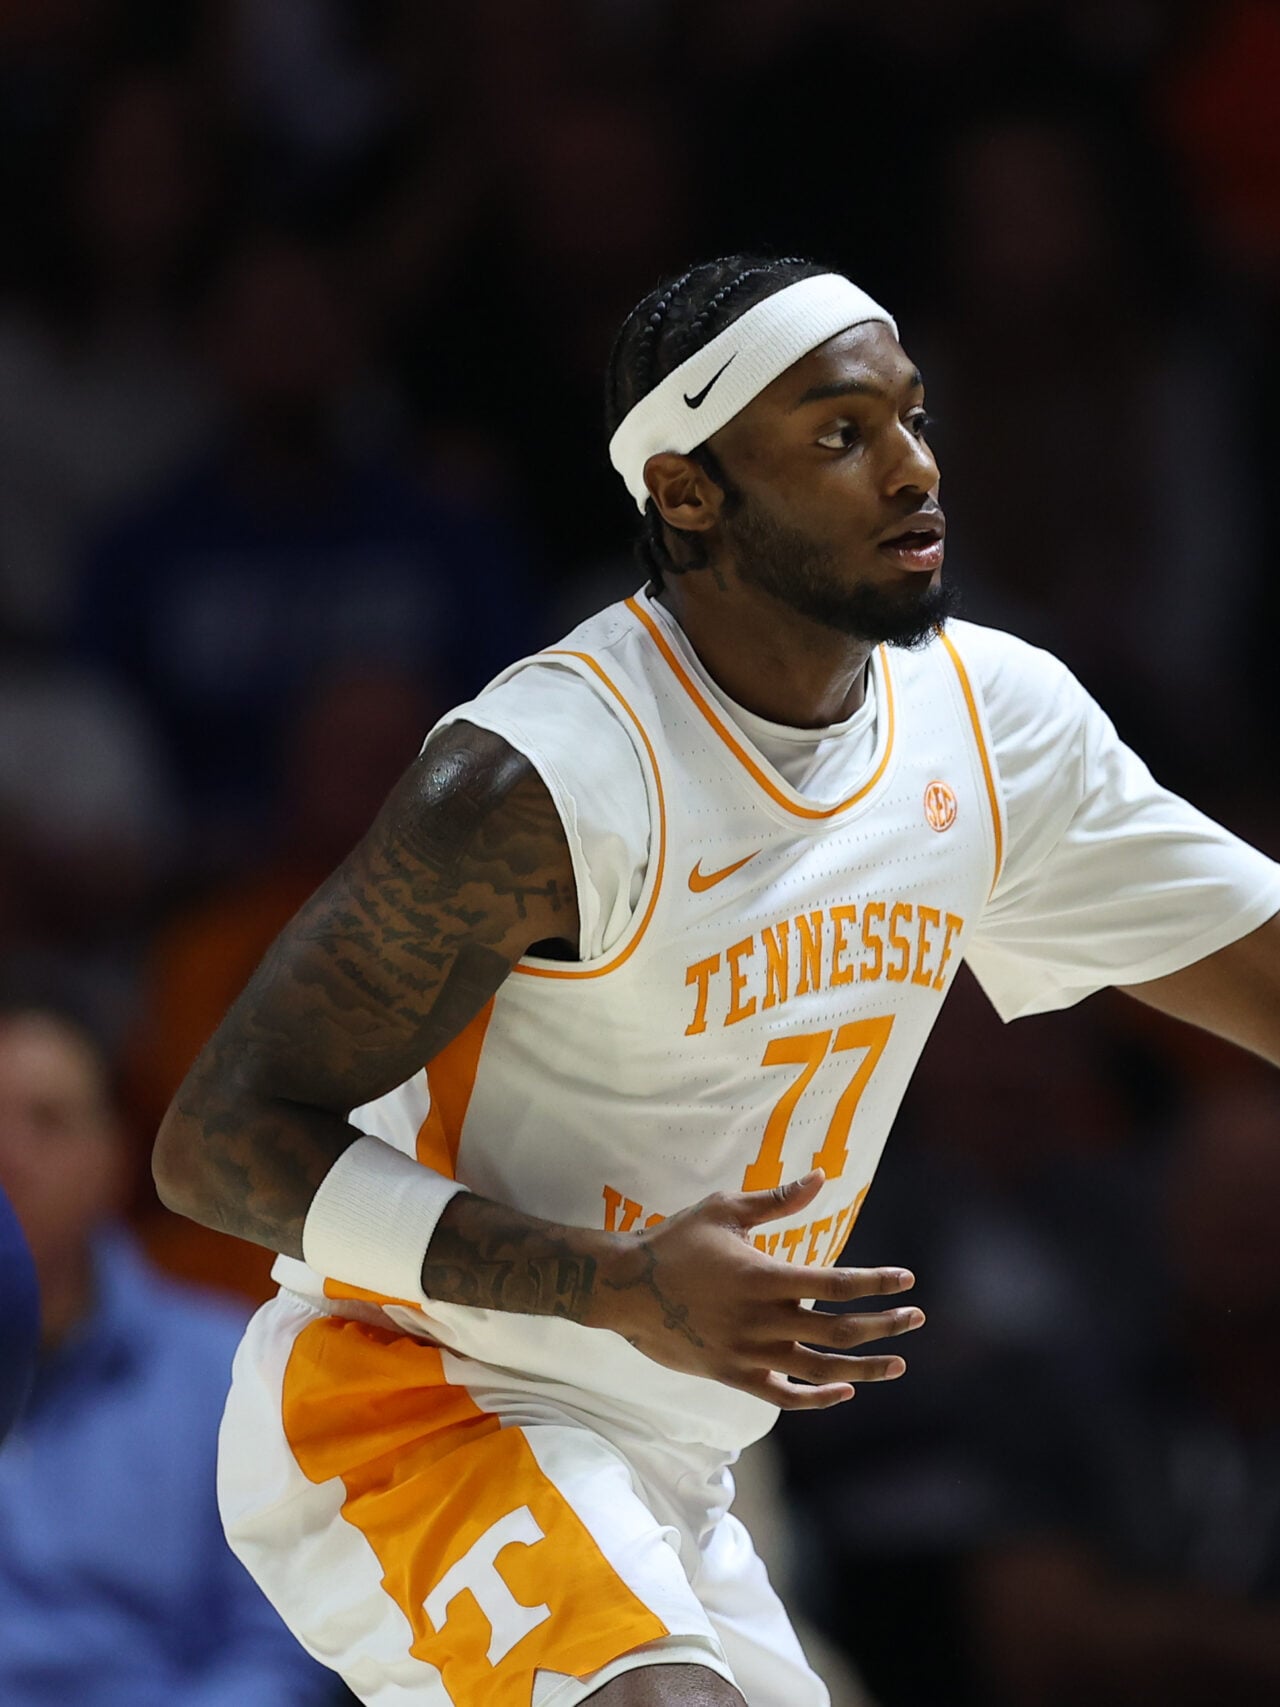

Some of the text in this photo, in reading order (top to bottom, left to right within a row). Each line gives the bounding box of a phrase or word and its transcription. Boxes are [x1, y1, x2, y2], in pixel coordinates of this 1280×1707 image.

[684, 901, 964, 1036] TENNESSEE
[741, 1014, 896, 1192] 77
[422, 1504, 552, 1668] T
